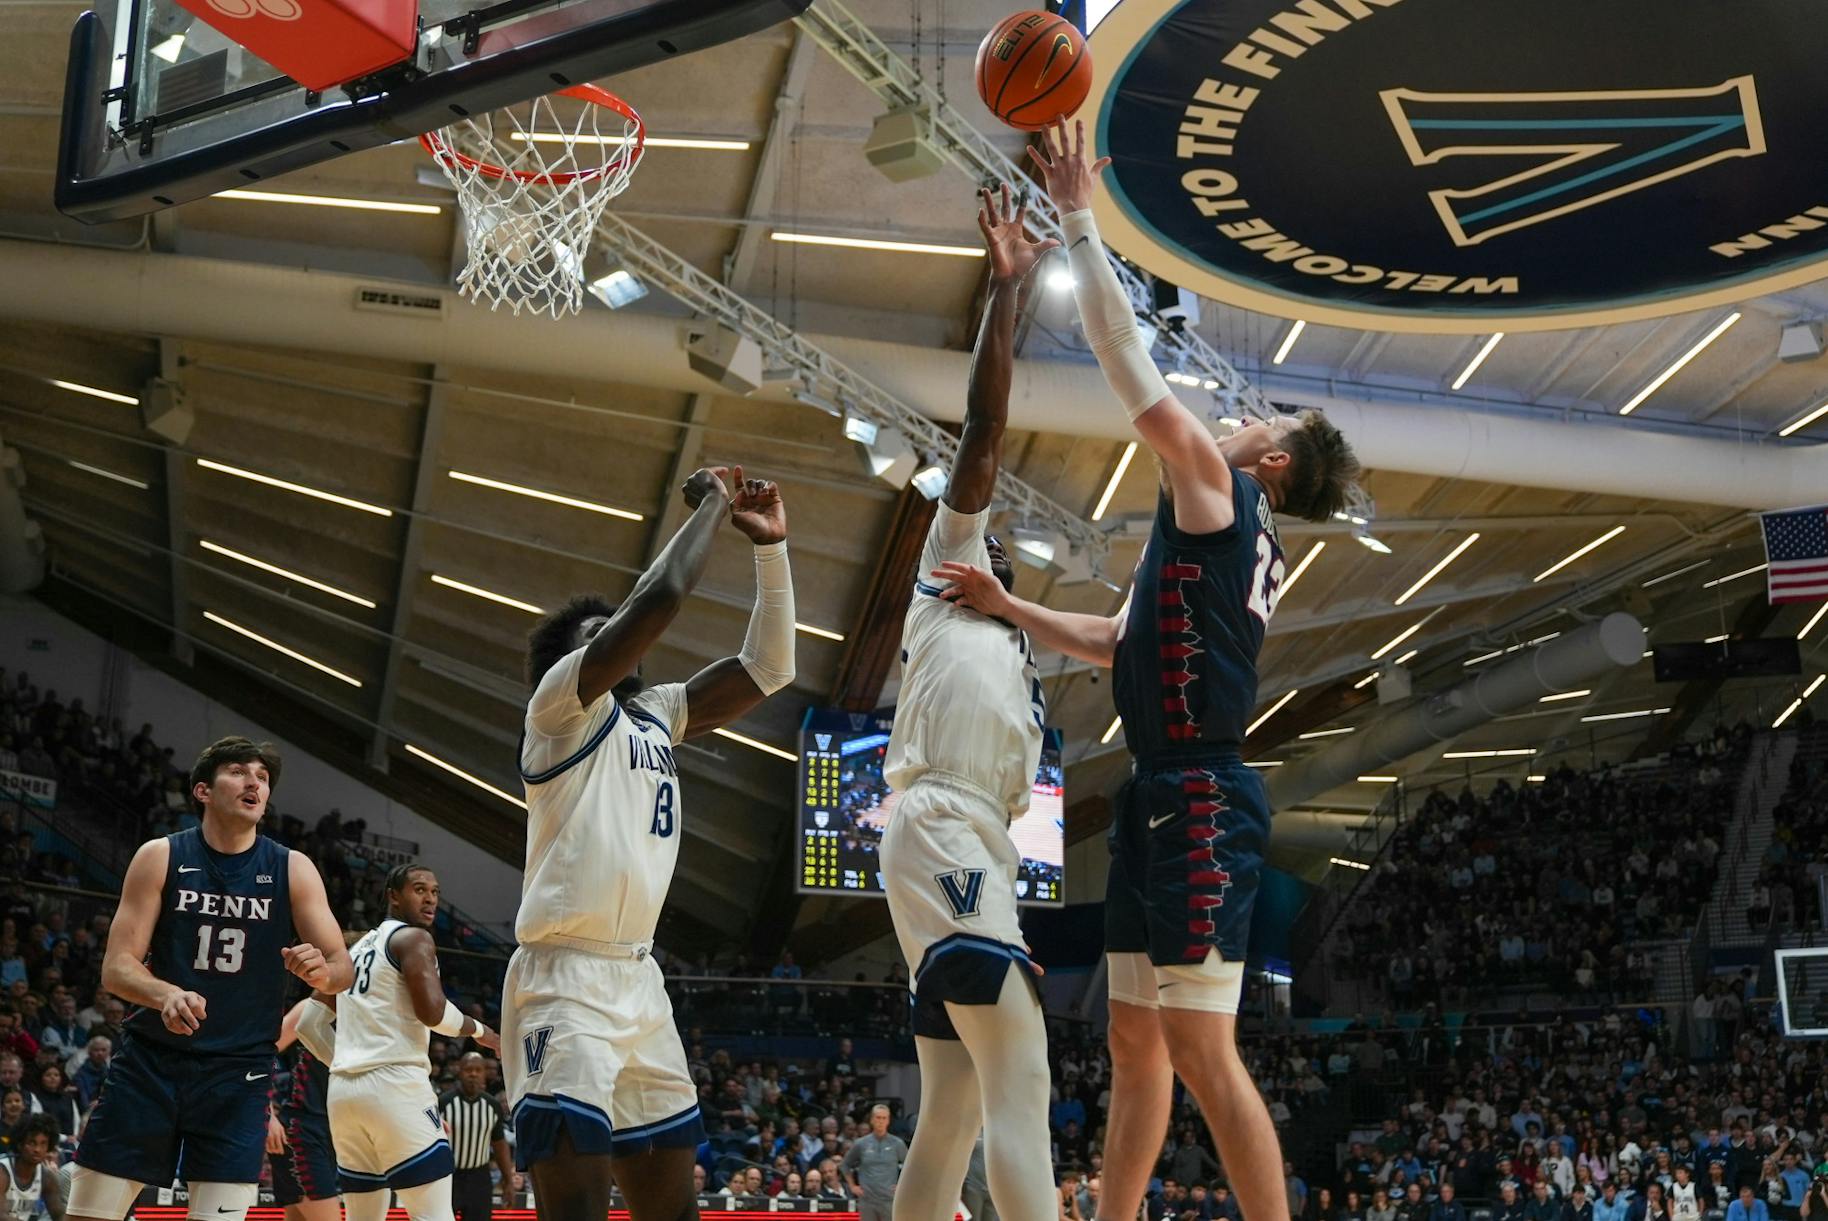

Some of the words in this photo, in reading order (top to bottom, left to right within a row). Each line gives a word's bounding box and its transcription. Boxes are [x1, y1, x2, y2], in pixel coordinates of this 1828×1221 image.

[1176, 78, 1261, 158] THE
[1379, 75, 1767, 247] V
[1181, 168, 1250, 217] TO
[1216, 217, 1519, 293] WELCOME
[649, 781, 673, 838] 13
[175, 889, 273, 920] PENN
[934, 868, 987, 920] V
[193, 925, 246, 973] 13
[523, 1026, 554, 1078] V
